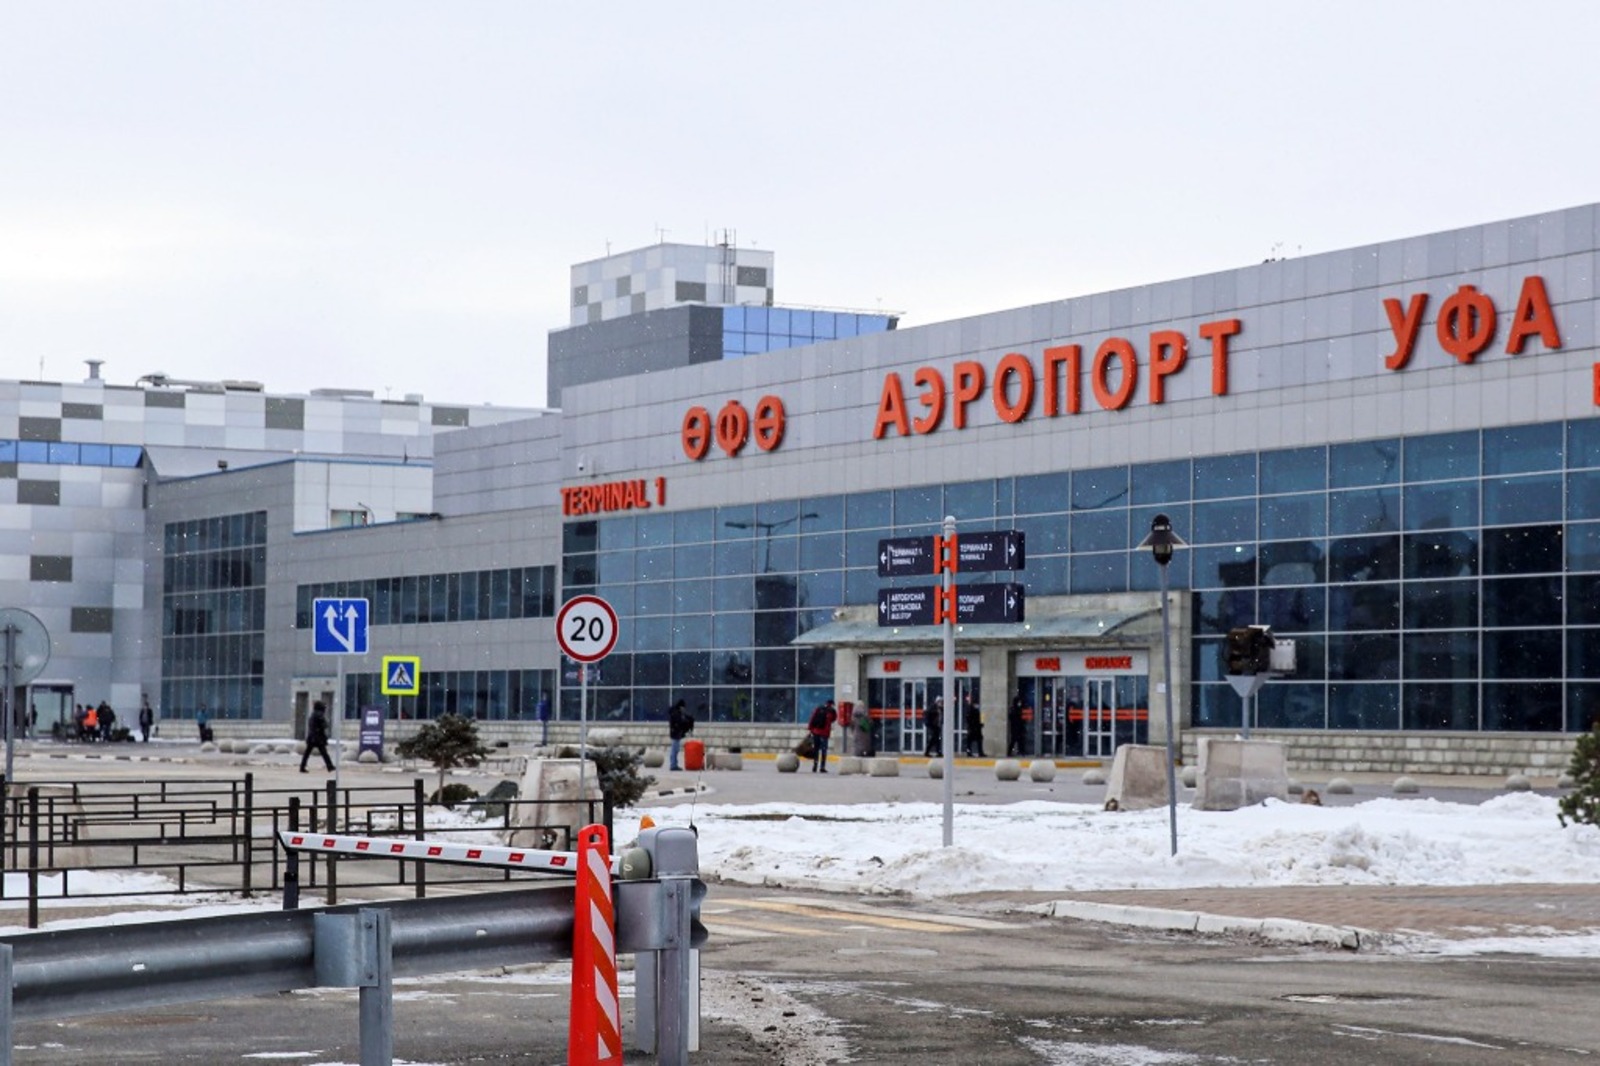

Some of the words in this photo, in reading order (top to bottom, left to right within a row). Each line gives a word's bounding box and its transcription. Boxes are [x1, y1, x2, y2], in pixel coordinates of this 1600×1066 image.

[1382, 275, 1562, 371] УФА
[873, 319, 1241, 439] АЭРОПОРТ
[560, 480, 651, 516] TERMINAL
[655, 476, 667, 506] 1
[960, 543, 988, 553] ТЕРМИНАЛ
[988, 543, 993, 551] 2
[958, 604, 975, 612] POLICE
[570, 616, 604, 642] 20
